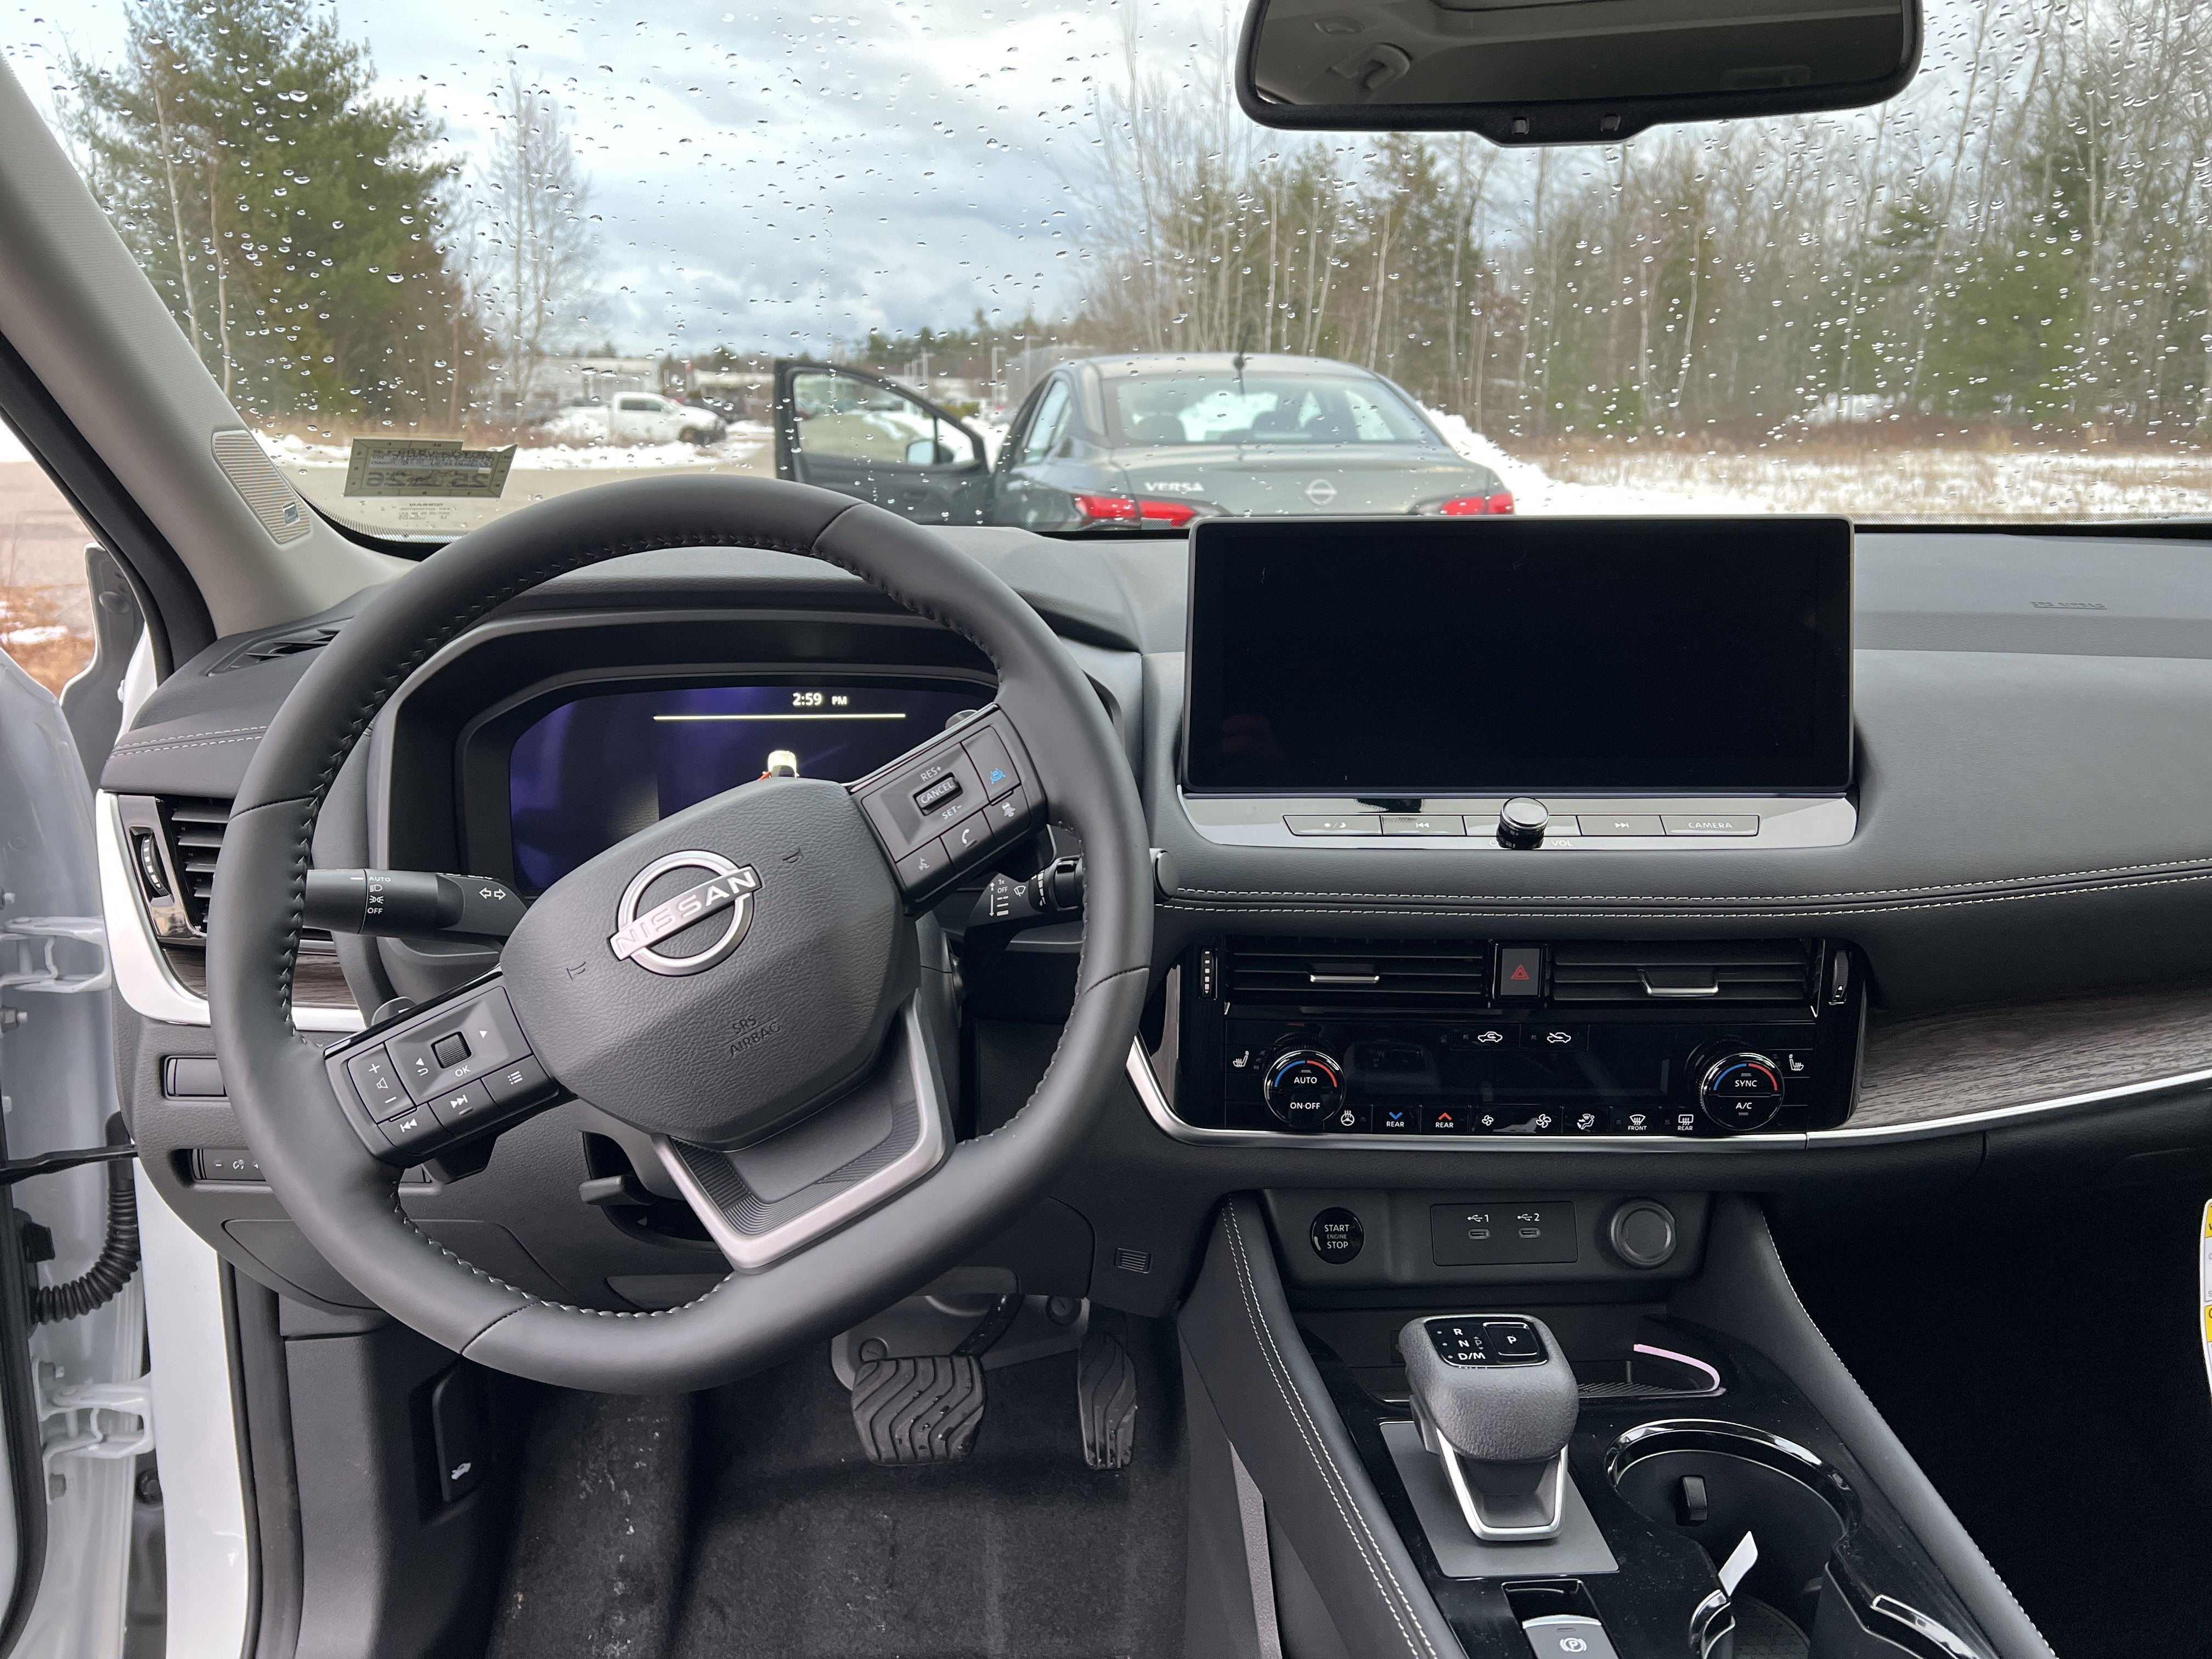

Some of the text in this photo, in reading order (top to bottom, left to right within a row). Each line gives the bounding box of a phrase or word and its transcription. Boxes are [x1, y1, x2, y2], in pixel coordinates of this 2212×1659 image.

[1144, 482, 1205, 492] VERSA
[793, 693, 847, 706] 2:59 PM
[920, 766, 941, 781] RES+
[921, 782, 954, 804] CANCEL
[942, 804, 962, 820] SET-
[616, 871, 757, 955] NISSAN
[732, 1015, 756, 1034] SRS
[730, 1022, 780, 1056] AIRBAG
[455, 1065, 470, 1077] OK
[1484, 1214, 1489, 1222] 1
[1534, 1213, 1540, 1221] 2
[1507, 1336, 1517, 1344] P
